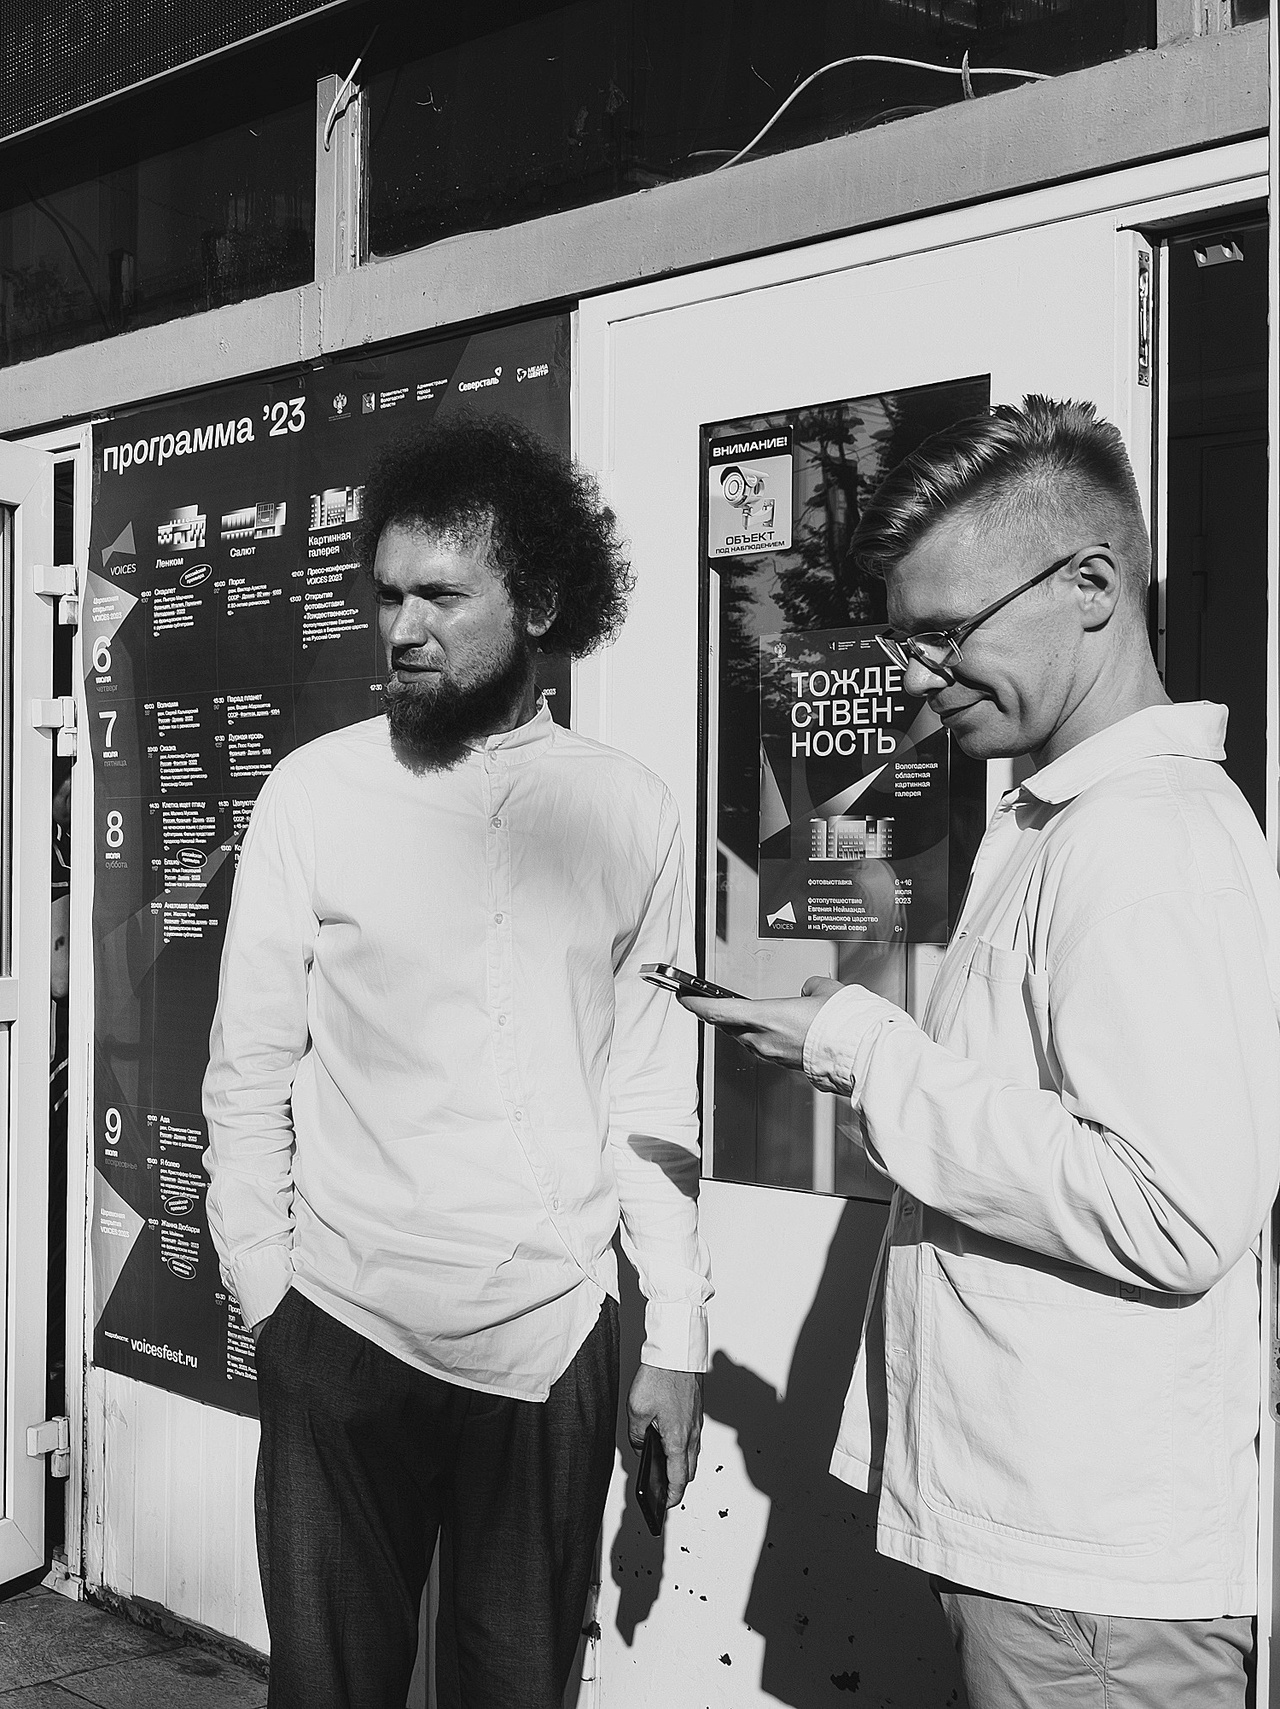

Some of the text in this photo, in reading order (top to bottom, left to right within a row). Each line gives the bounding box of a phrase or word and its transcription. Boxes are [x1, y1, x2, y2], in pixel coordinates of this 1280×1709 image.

[458, 375, 500, 393] Северсталь
[103, 417, 255, 475] программа
[713, 436, 788, 457] ВНИМАНИЕ!
[308, 531, 352, 547] Картинная
[725, 531, 775, 545] ОБЪЕКТ
[230, 546, 256, 557] Салют
[308, 545, 340, 558] галерея
[731, 540, 785, 552] НАБЛЮДЕНИЕМ
[110, 563, 137, 576] VOICES
[155, 558, 184, 569] Ленком
[306, 573, 343, 586] VOICES 2023
[92, 635, 112, 673] 6
[790, 665, 903, 698] ТОЖДЕ
[791, 696, 905, 728] СТВЕН-
[98, 710, 117, 748] 7
[791, 727, 896, 758] НОСТЬ
[895, 762, 939, 770] Вологодская
[895, 781, 931, 789] картинная
[106, 810, 124, 848] 8
[807, 878, 853, 886] фотовыставка
[807, 897, 863, 905] фотопутешествие
[833, 905, 866, 914] Нейманда
[812, 914, 851, 923] Бирманское
[821, 923, 848, 932] Русский
[105, 1108, 122, 1145] 9
[131, 1338, 198, 1369] voicesfest.ru
